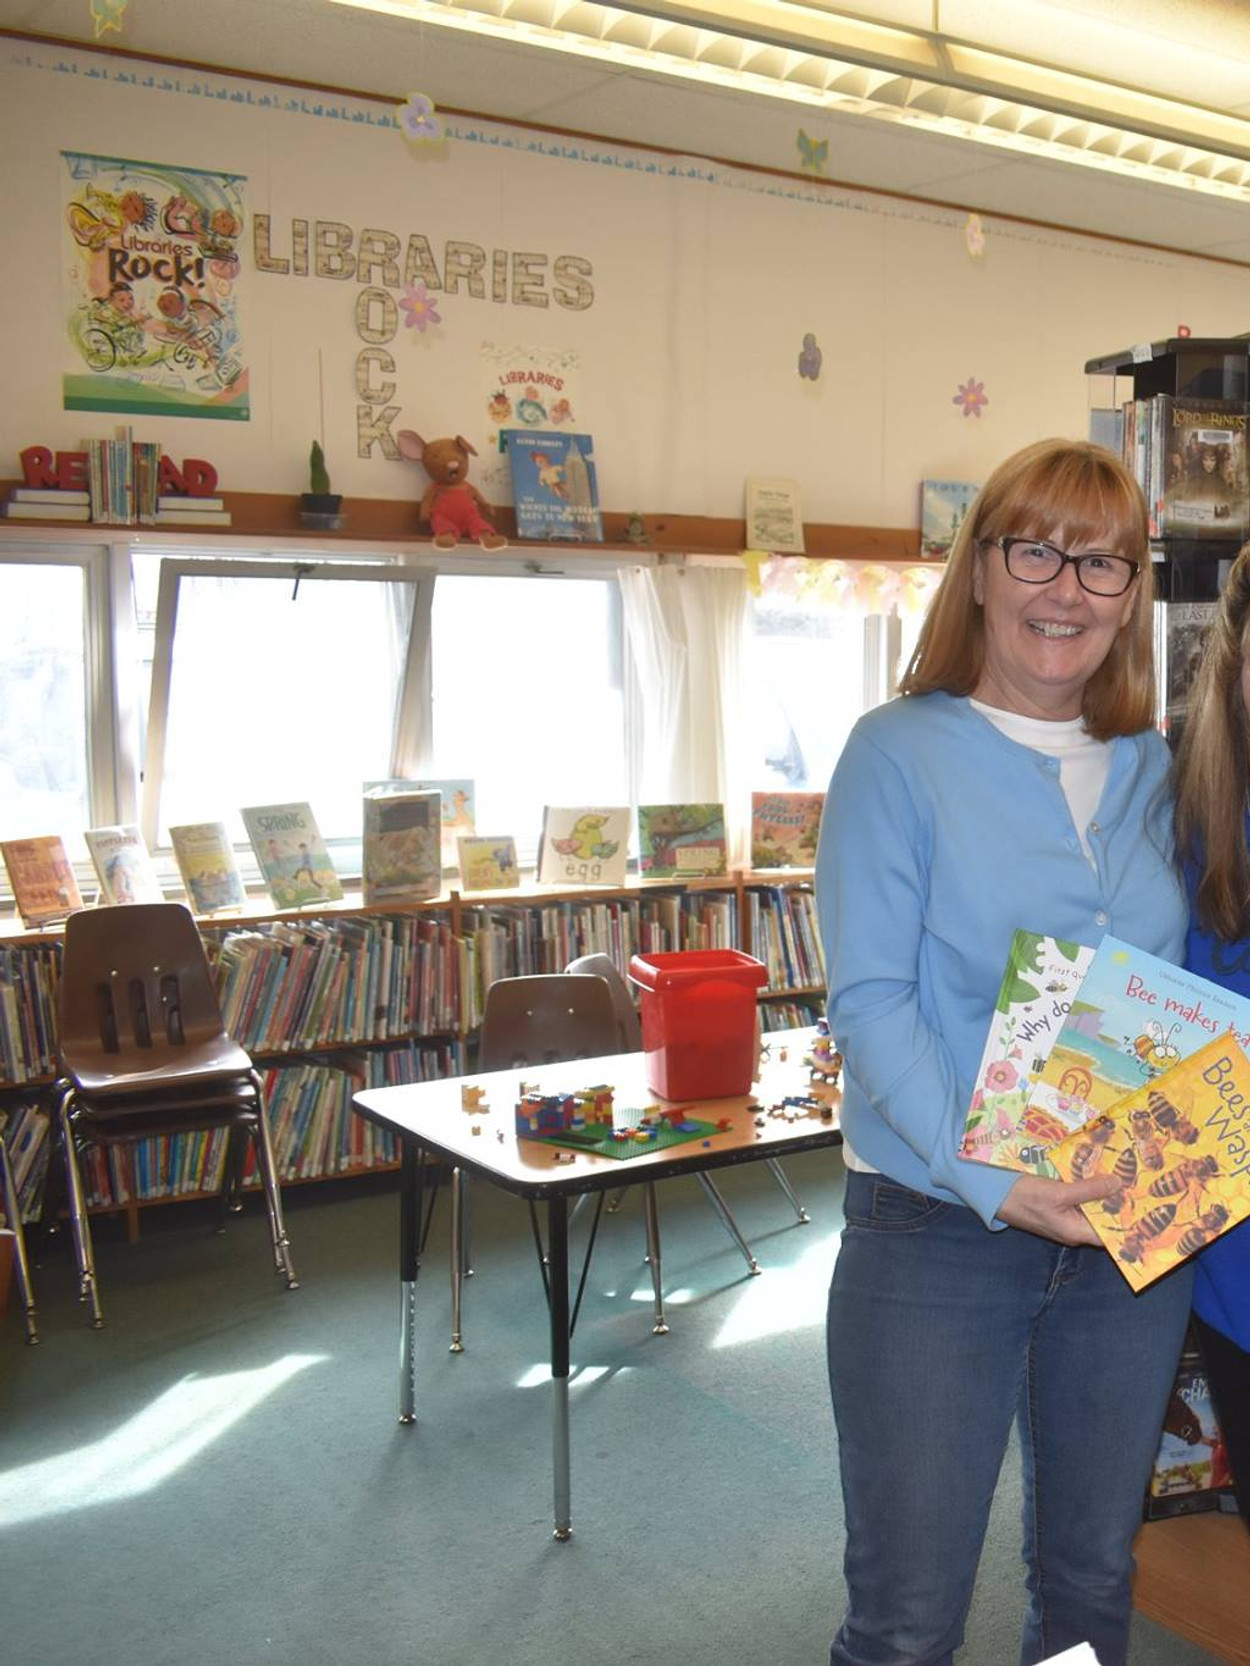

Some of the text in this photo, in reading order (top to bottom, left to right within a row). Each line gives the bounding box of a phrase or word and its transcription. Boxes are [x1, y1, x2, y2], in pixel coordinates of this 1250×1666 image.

[121, 234, 193, 256] Libraries
[252, 212, 595, 312] LIBRARIES
[499, 371, 564, 391] LIBRARIES
[1173, 408, 1250, 429] LORD RINGS
[258, 812, 306, 833] SPRING
[565, 862, 602, 878] egg
[1048, 964, 1070, 979] First
[1125, 974, 1158, 1007] Bee
[1164, 994, 1219, 1034] makes
[1015, 1000, 1072, 1045] Why do
